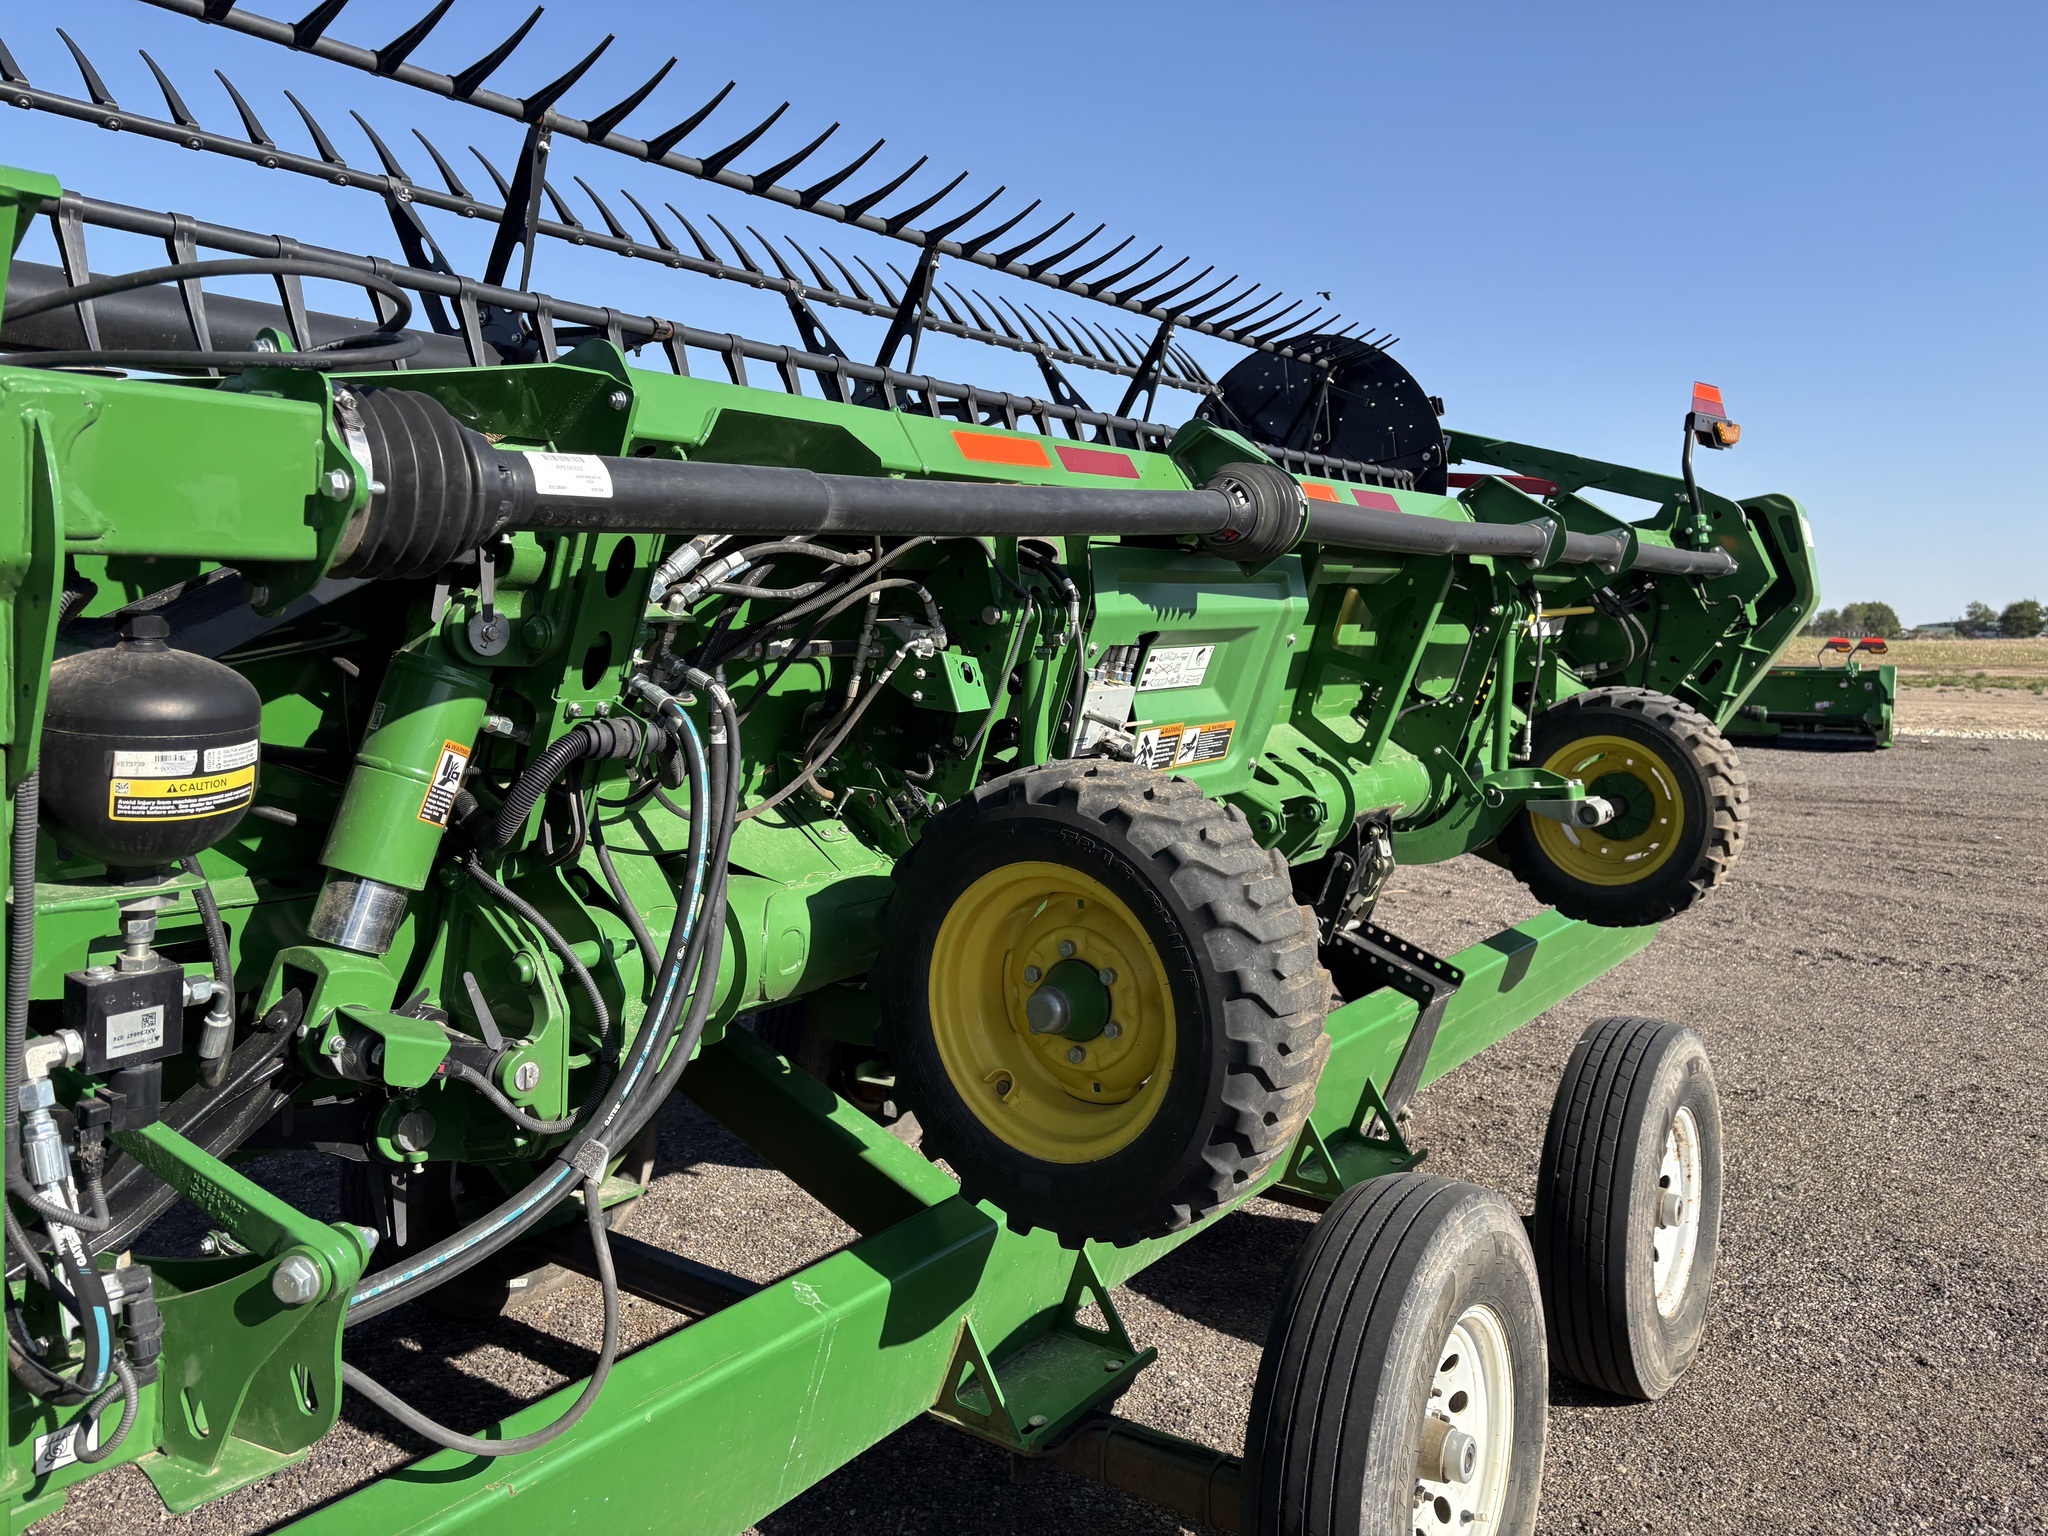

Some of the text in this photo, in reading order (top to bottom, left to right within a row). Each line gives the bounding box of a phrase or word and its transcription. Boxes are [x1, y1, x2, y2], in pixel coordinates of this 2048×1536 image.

[179, 778, 228, 793] CAUTION
[172, 797, 197, 805] machine
[167, 807, 194, 815] servicing
[195, 805, 216, 814] system.
[604, 1101, 621, 1127] GATES
[65, 1226, 88, 1267] GATES
